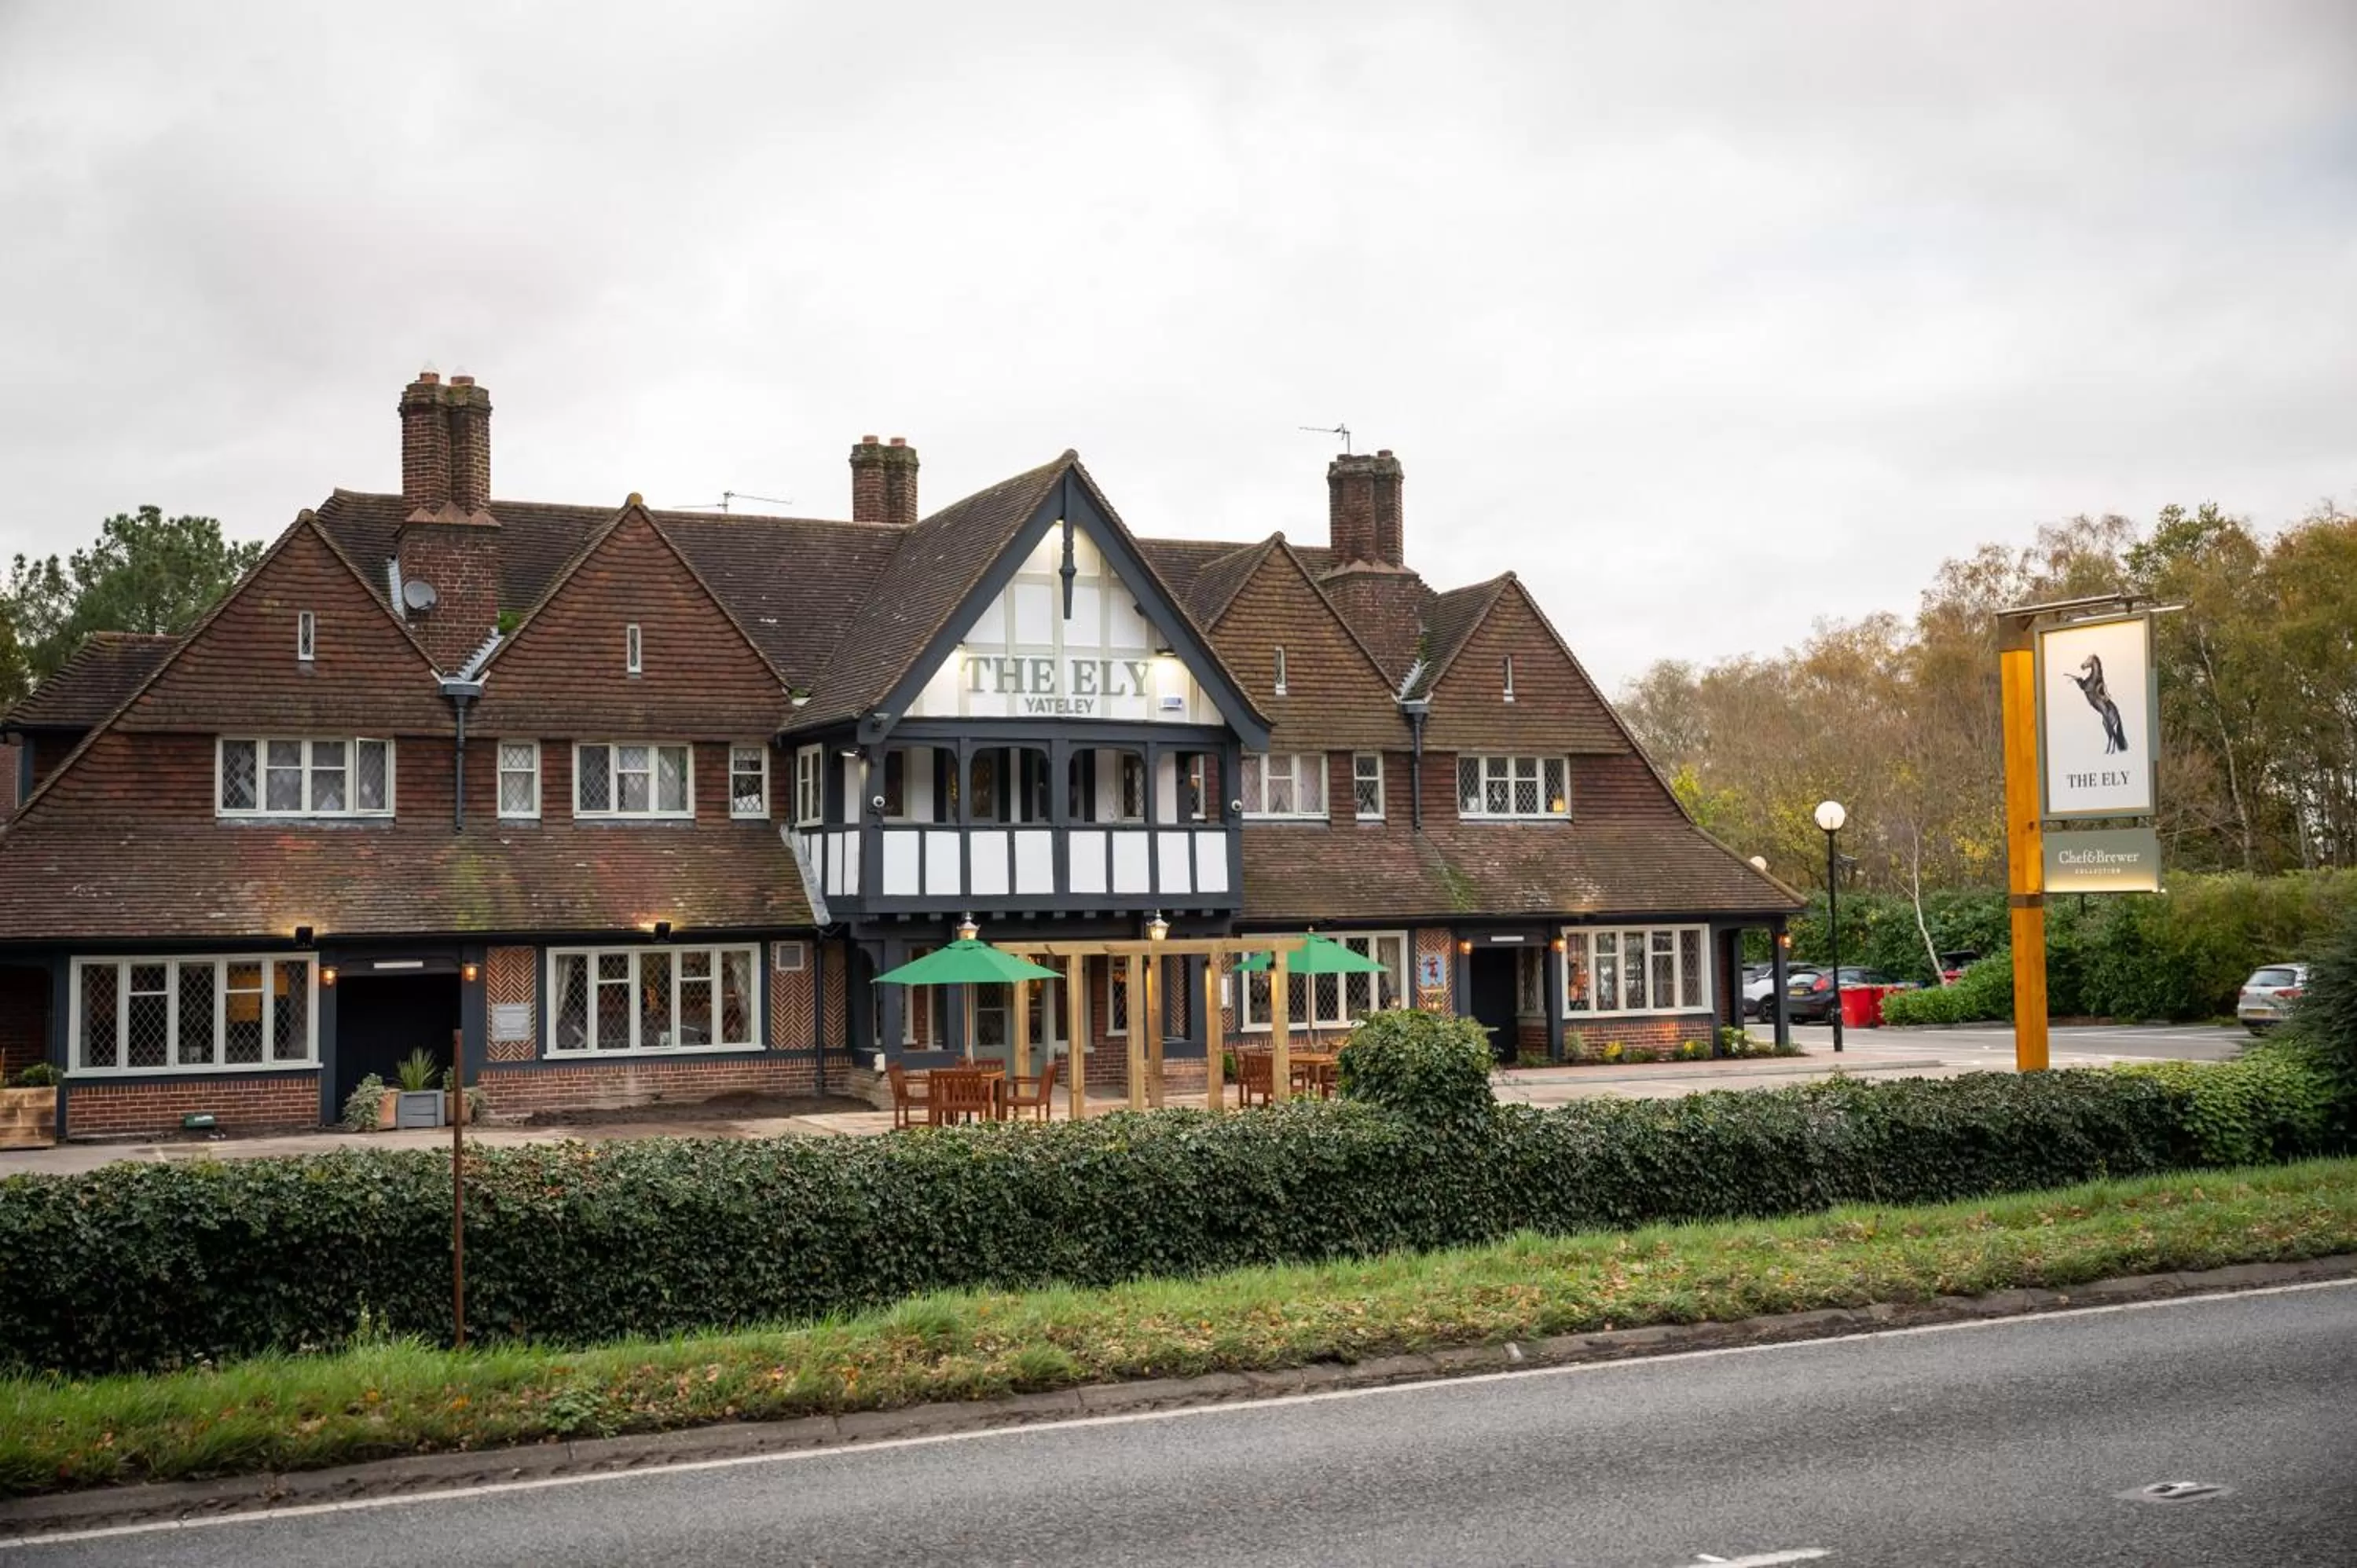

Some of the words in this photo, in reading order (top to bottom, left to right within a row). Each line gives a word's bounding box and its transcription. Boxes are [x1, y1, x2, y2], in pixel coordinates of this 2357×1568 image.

[963, 657, 1055, 694] THE
[1072, 659, 1153, 696] ELY
[1025, 698, 1094, 714] YATELEY
[2066, 773, 2097, 788] THE
[2102, 771, 2130, 786] ELY
